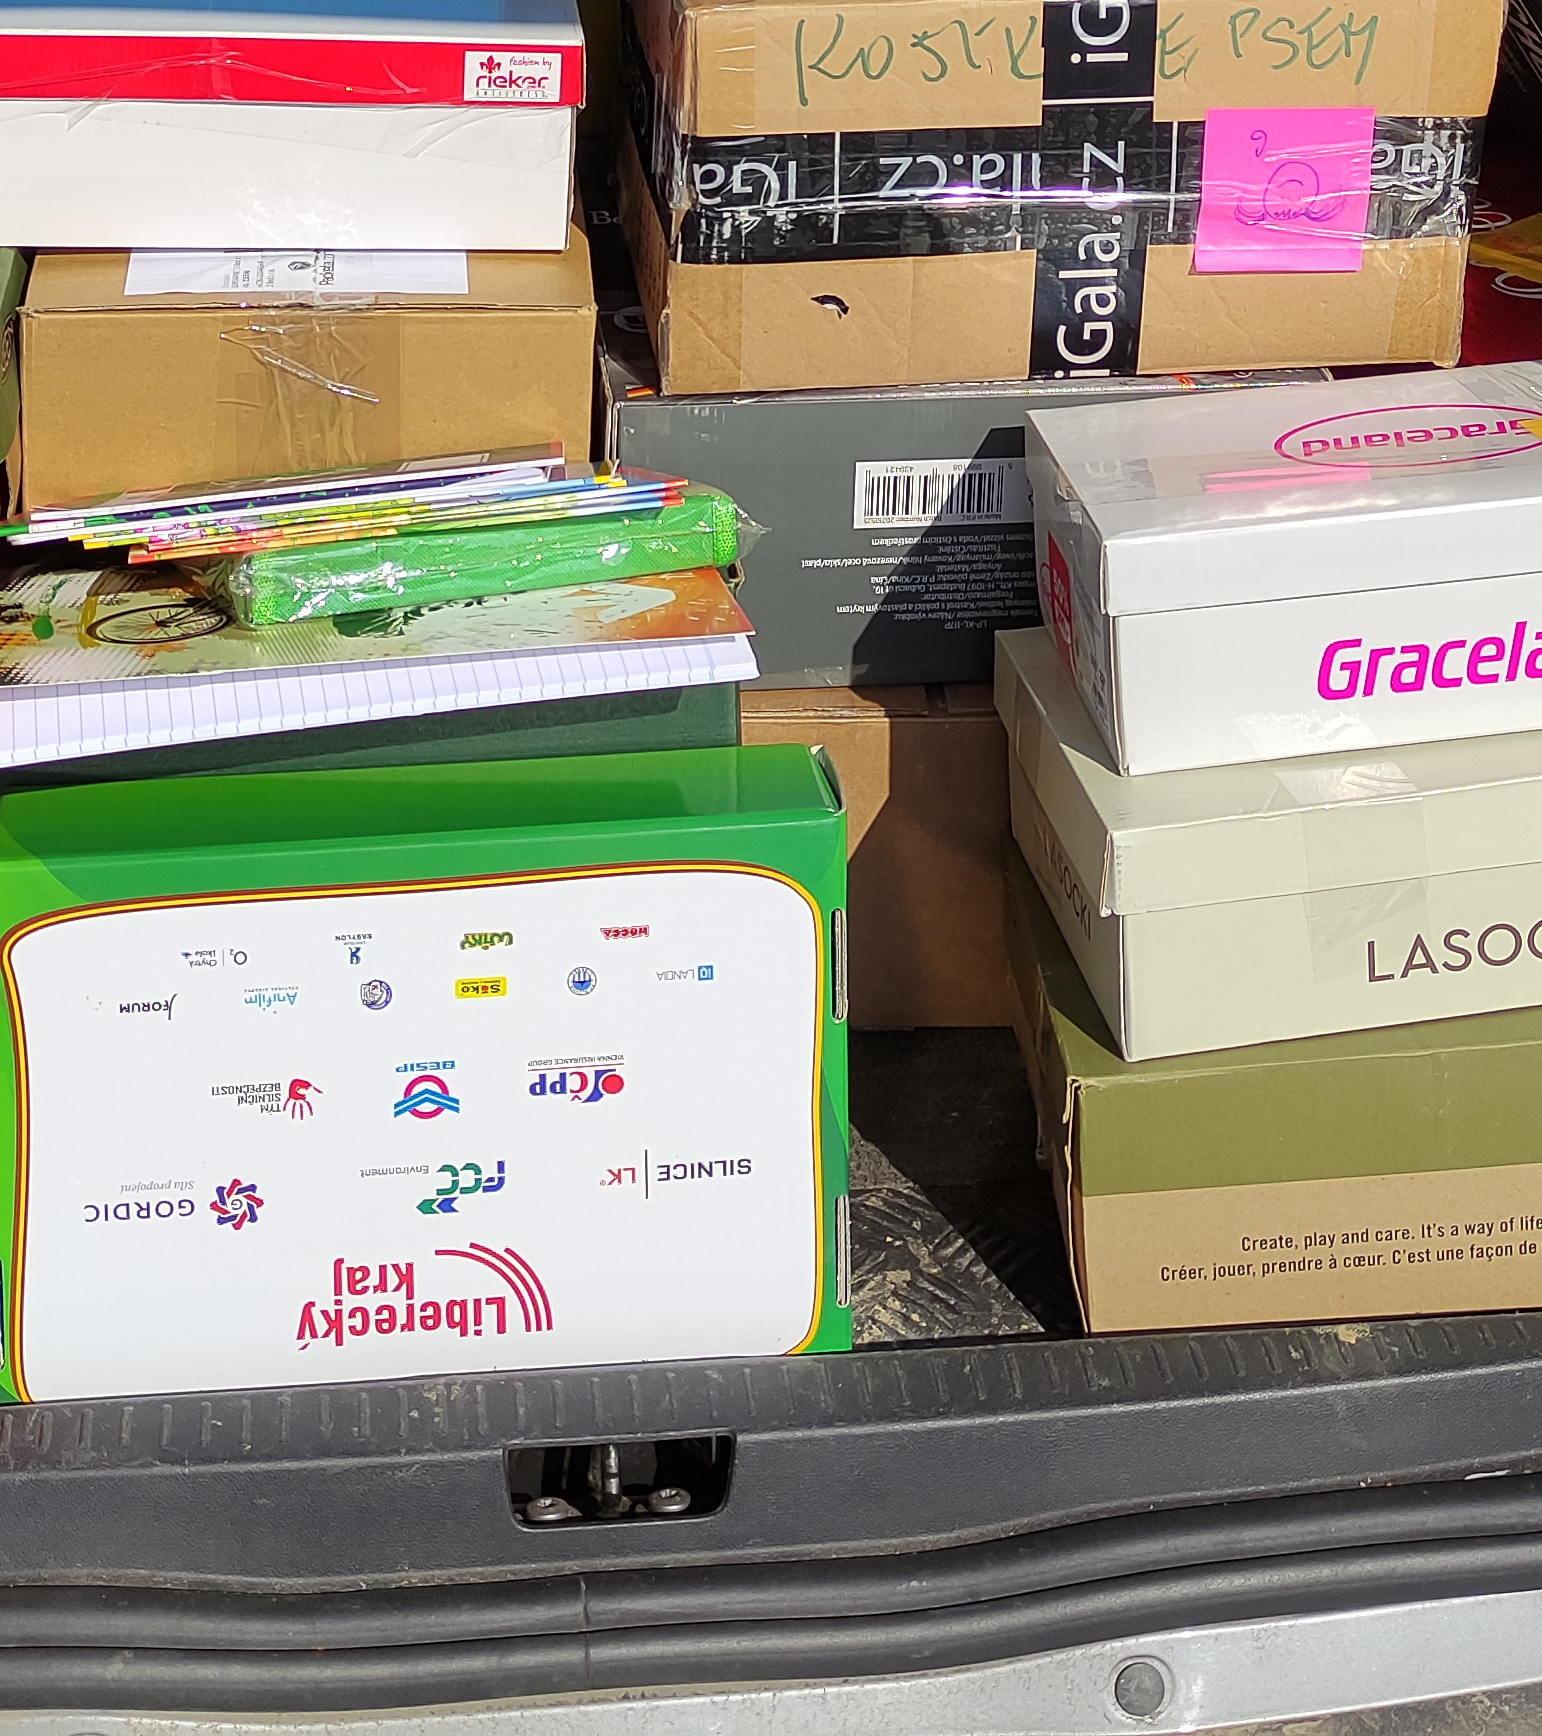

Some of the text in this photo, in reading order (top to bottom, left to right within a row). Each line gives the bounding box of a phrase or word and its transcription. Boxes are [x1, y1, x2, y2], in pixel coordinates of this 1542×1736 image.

[475, 70, 549, 89] rieker
[1055, 139, 1126, 380] iGala.cz
[244, 991, 299, 1012] Anifilm
[395, 1060, 457, 1074] BESIP
[528, 1071, 589, 1102] ČPP
[260, 1104, 282, 1115] TÝM
[359, 1159, 507, 1196] FCC Environment
[657, 1157, 753, 1182] SILNICE
[83, 1198, 196, 1224] GORDIC
[1241, 1233, 1299, 1253] Create,
[1304, 1231, 1337, 1250] play
[1341, 1228, 1370, 1245] and
[1375, 1227, 1416, 1243] care.
[1421, 1223, 1445, 1240] It's
[1450, 1225, 1460, 1237] a
[1464, 1221, 1495, 1238] way
[1499, 1215, 1515, 1233] of
[1160, 1264, 1208, 1282] Créer,
[1212, 1263, 1257, 1282] jouer,
[1261, 1255, 1323, 1278] prendre
[1328, 1253, 1338, 1270] à
[1343, 1252, 1387, 1269] cœur.
[1392, 1247, 1431, 1265] C'est
[1436, 1247, 1465, 1263] une
[1469, 1242, 1514, 1263] façon
[1519, 1240, 1538, 1256] de
[332, 1258, 416, 1302] kraj
[296, 1297, 508, 1351] Liberecký
